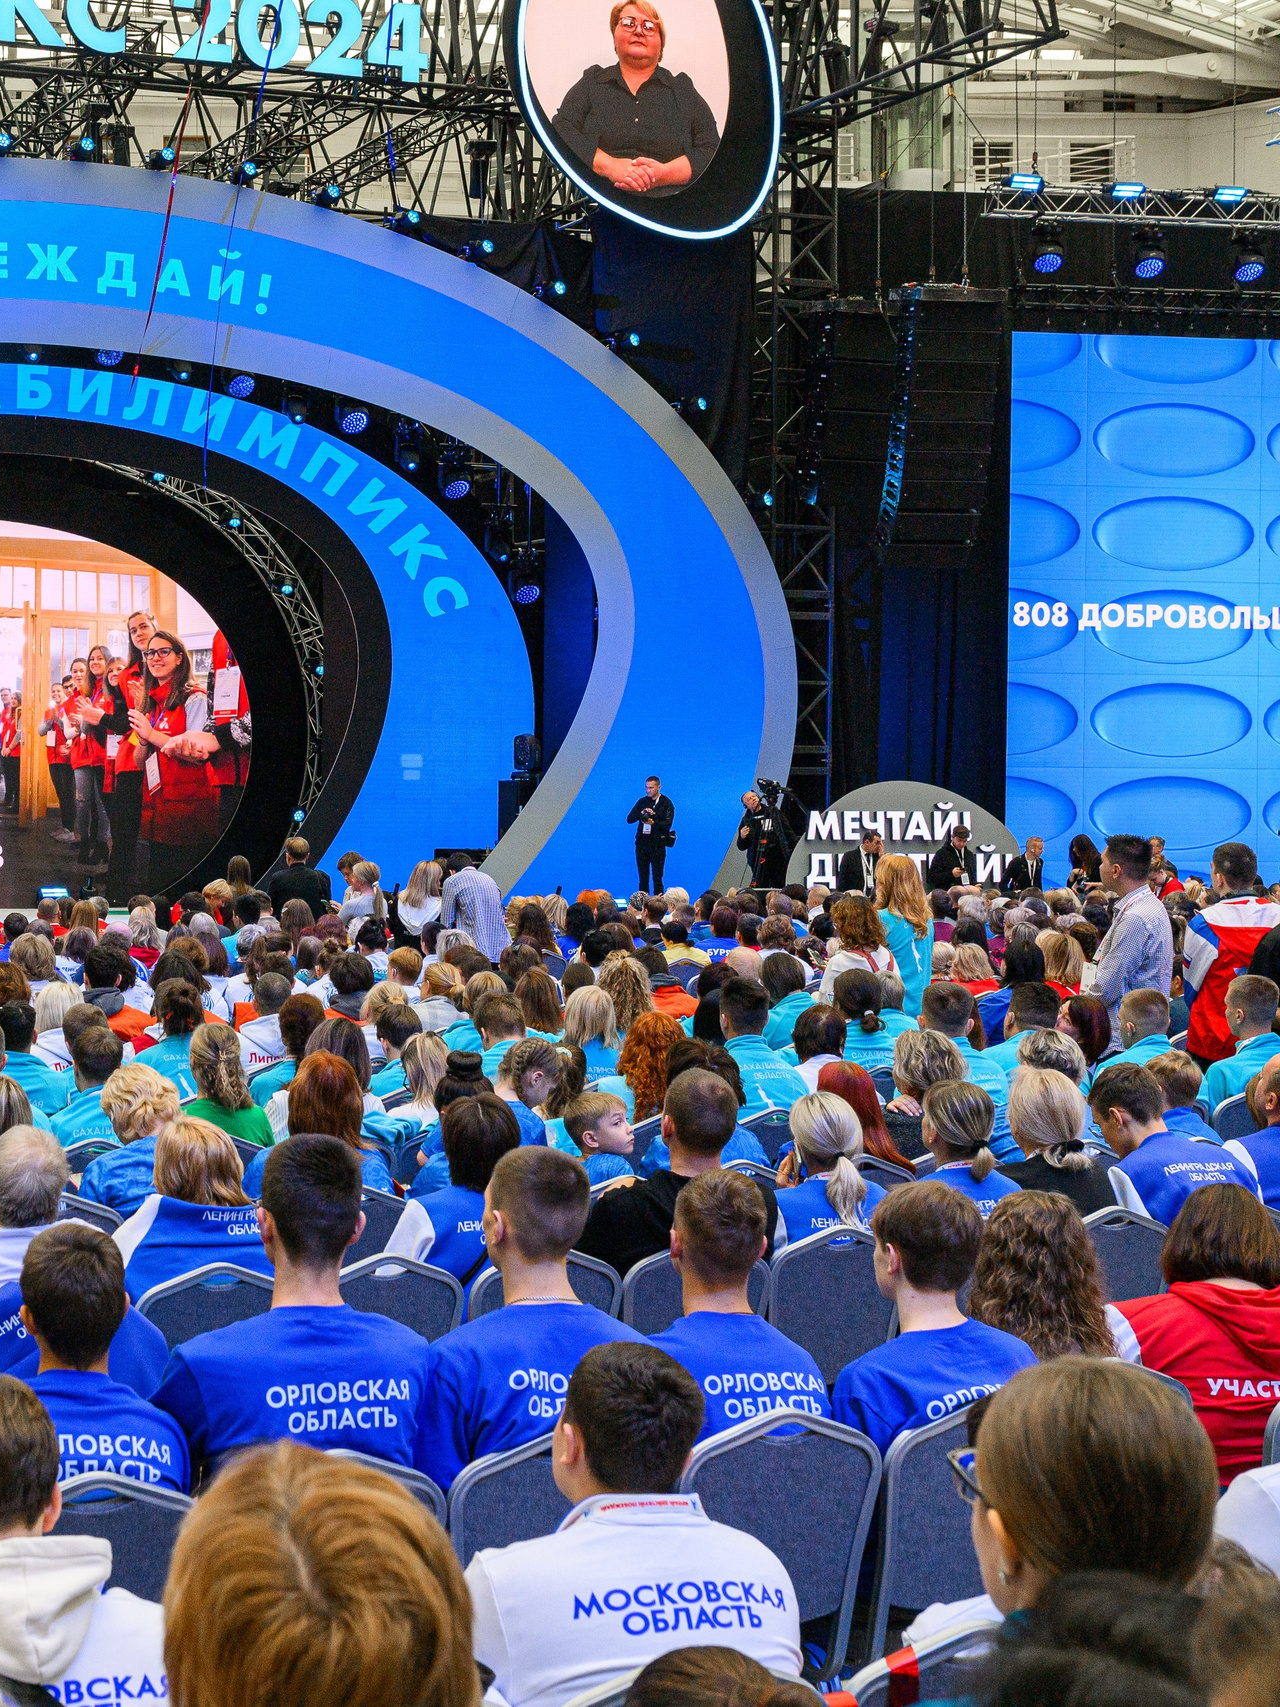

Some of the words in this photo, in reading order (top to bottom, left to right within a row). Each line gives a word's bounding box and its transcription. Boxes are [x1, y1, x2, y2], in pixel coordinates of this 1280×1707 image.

[173, 0, 428, 82] 2024
[1013, 601, 1069, 627] 808
[1078, 603, 1280, 631] ДОБРОВОЛЬ
[1163, 1162, 1236, 1177] ЛЕНИНГРАДСКАЯ
[1188, 1172, 1227, 1182] ОБЛАСТЬ
[202, 1208, 258, 1222] ЛЕНИНГРА
[227, 1222, 261, 1236] ОБЛАС
[509, 1369, 572, 1391] ОРЛО
[704, 1371, 825, 1396] ОРЛОВСКАЯ
[1206, 1378, 1280, 1398] УЧАСТ
[266, 1378, 410, 1409] ОРЛОВСКАЯ
[288, 1406, 398, 1434] ОБЛАСТЬ
[58, 1434, 171, 1466] ЛОВСКАЯ
[573, 1580, 786, 1620] МОСКОВСКАЯ
[622, 1605, 763, 1636] ОБЛАСТЬ
